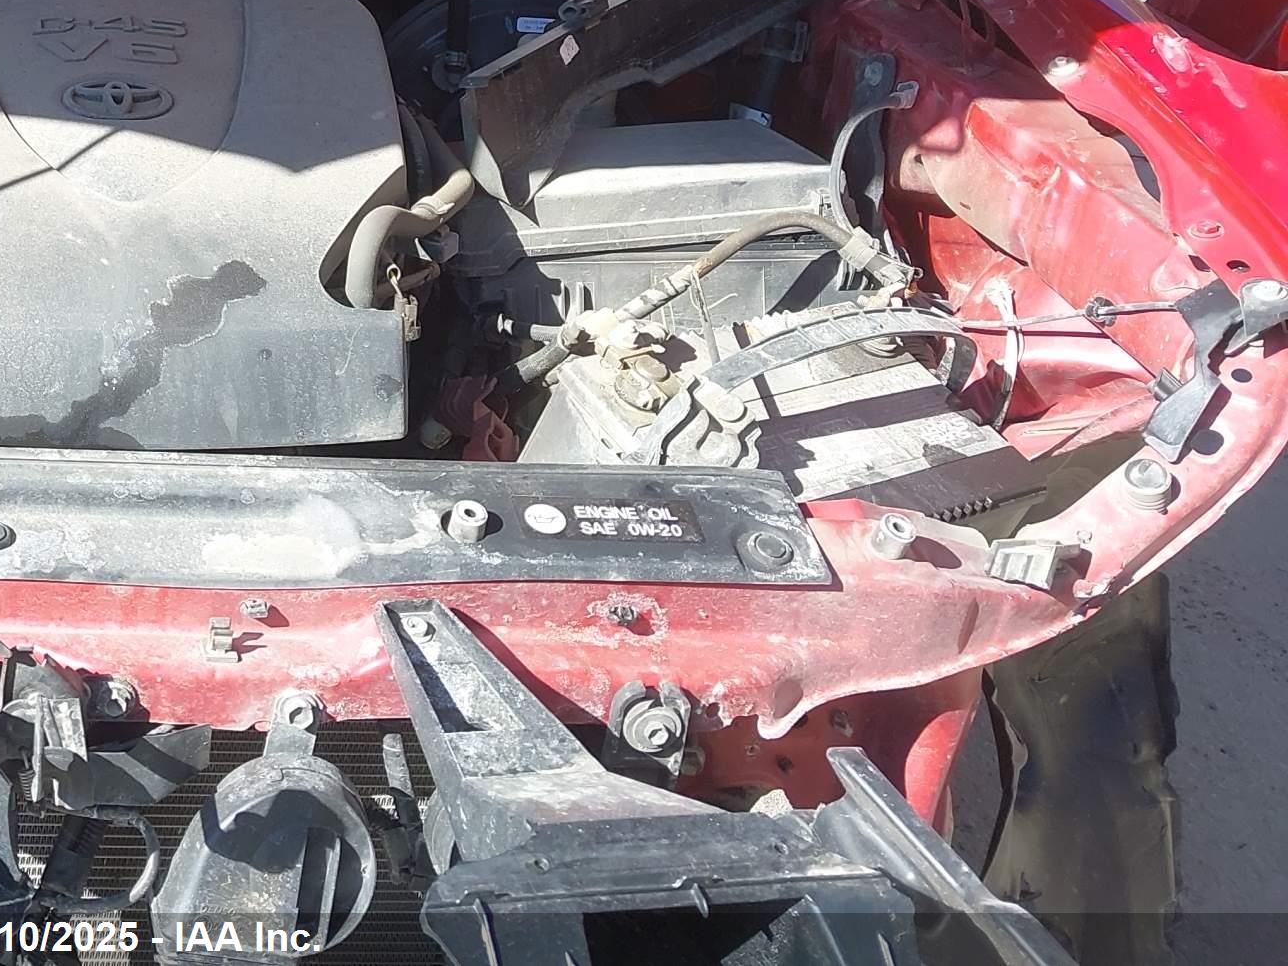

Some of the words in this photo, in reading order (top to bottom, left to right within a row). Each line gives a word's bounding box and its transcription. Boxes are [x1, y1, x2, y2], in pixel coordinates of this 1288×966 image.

[37, 38, 179, 65] V6
[573, 505, 639, 520] ENGINE
[647, 507, 679, 521] OIL
[580, 522, 617, 536] SAE
[627, 523, 683, 537] 0W-20
